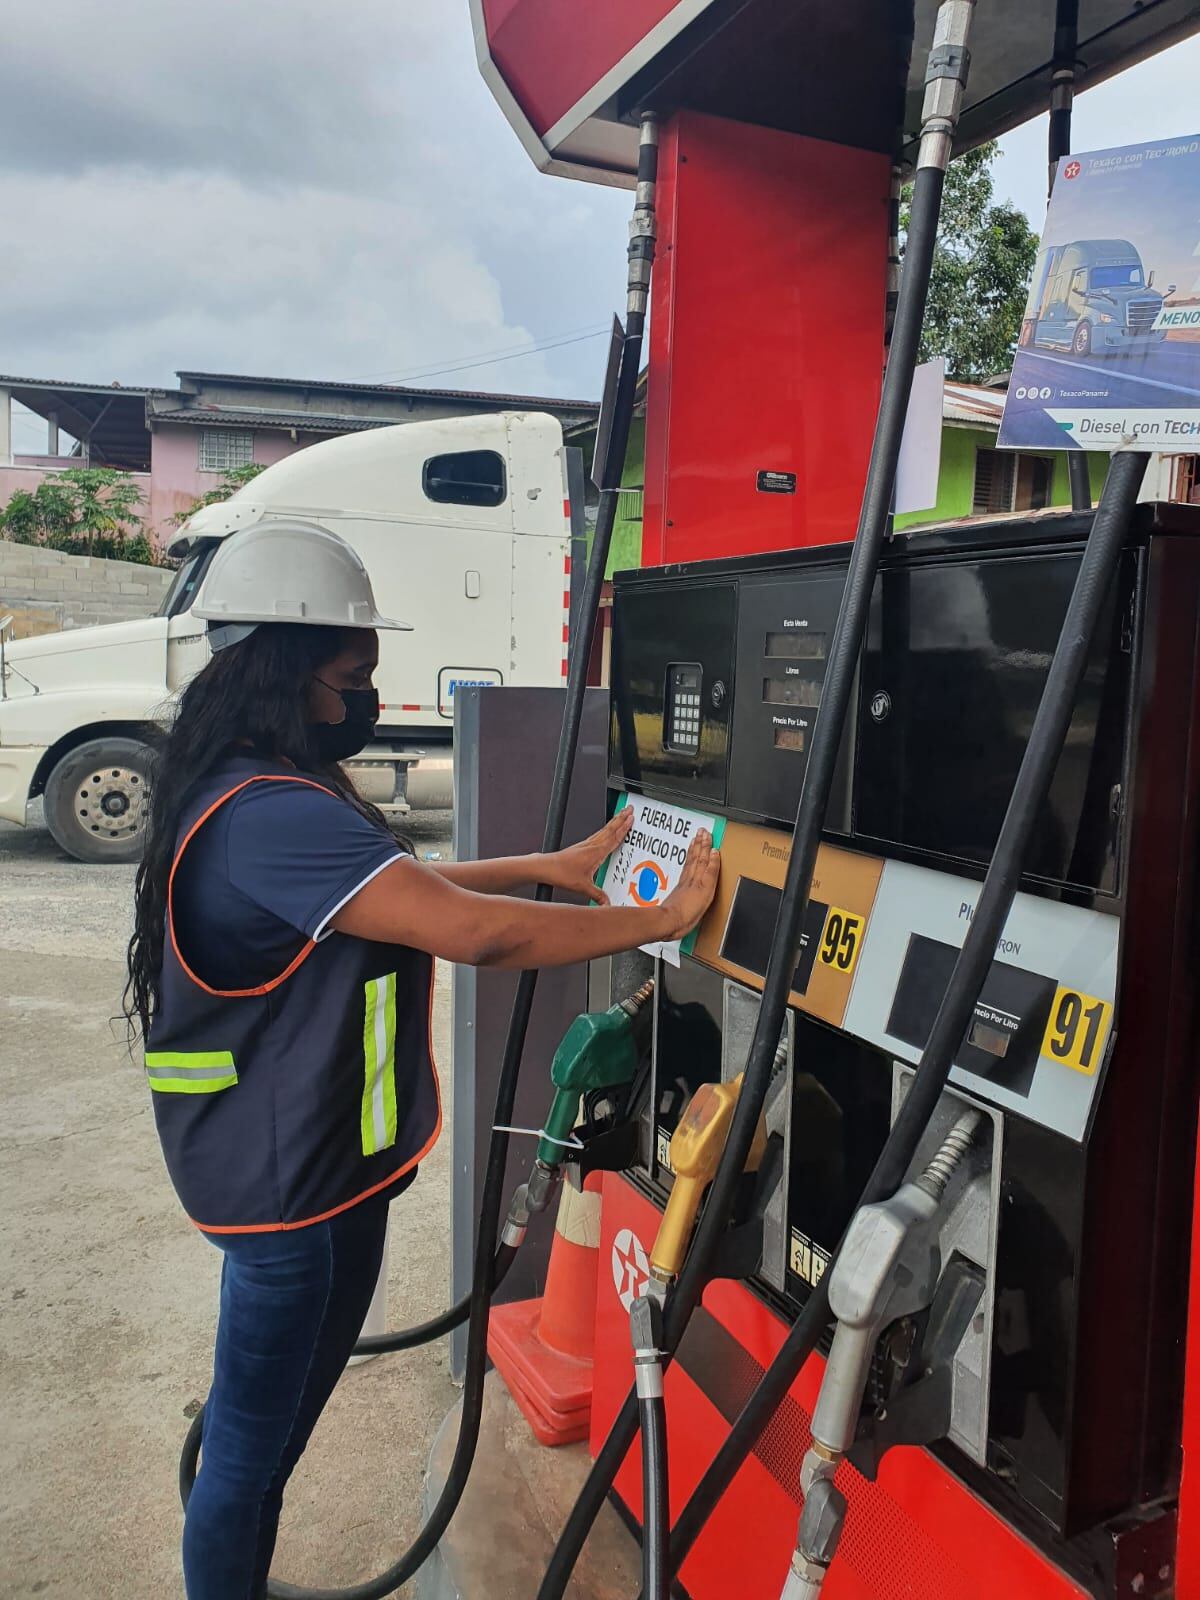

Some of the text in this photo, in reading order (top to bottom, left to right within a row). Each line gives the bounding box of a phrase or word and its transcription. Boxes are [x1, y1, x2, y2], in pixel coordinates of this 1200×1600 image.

[1088, 157, 1122, 169] Texaco
[1125, 153, 1142, 162] con
[1160, 311, 1200, 326] MENO
[1080, 418, 1126, 433] Diesel
[1133, 423, 1160, 434] con
[640, 806, 692, 838] FUERA DE
[624, 828, 669, 859] SERVICIO
[821, 914, 859, 970] 95
[990, 1012, 1002, 1024] Por
[1002, 1017, 1019, 1030] Litro
[1050, 992, 1105, 1068] 91
